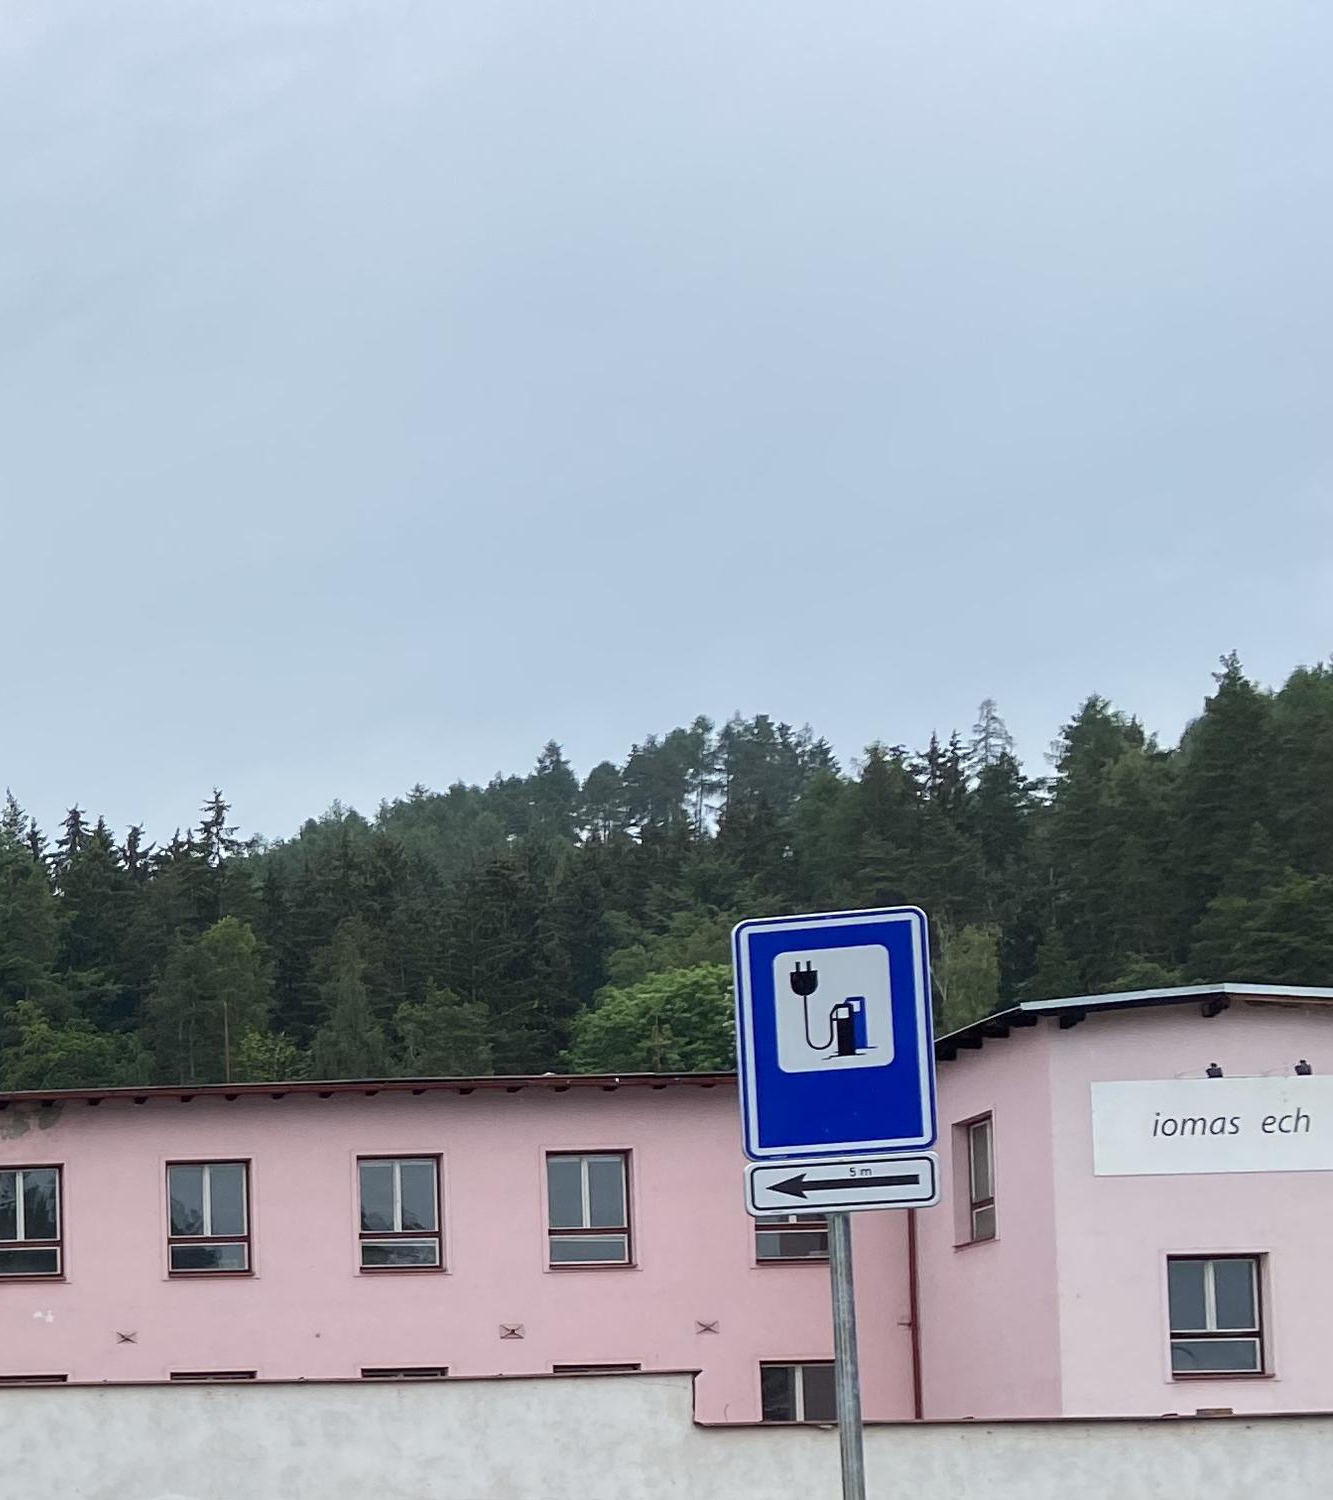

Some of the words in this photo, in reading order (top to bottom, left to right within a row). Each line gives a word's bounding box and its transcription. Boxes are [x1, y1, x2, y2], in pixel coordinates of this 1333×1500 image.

[1153, 1112, 1241, 1136] iomas
[1261, 1107, 1311, 1133] ech
[849, 1167, 857, 1177] 5
[860, 1168, 872, 1176] m
